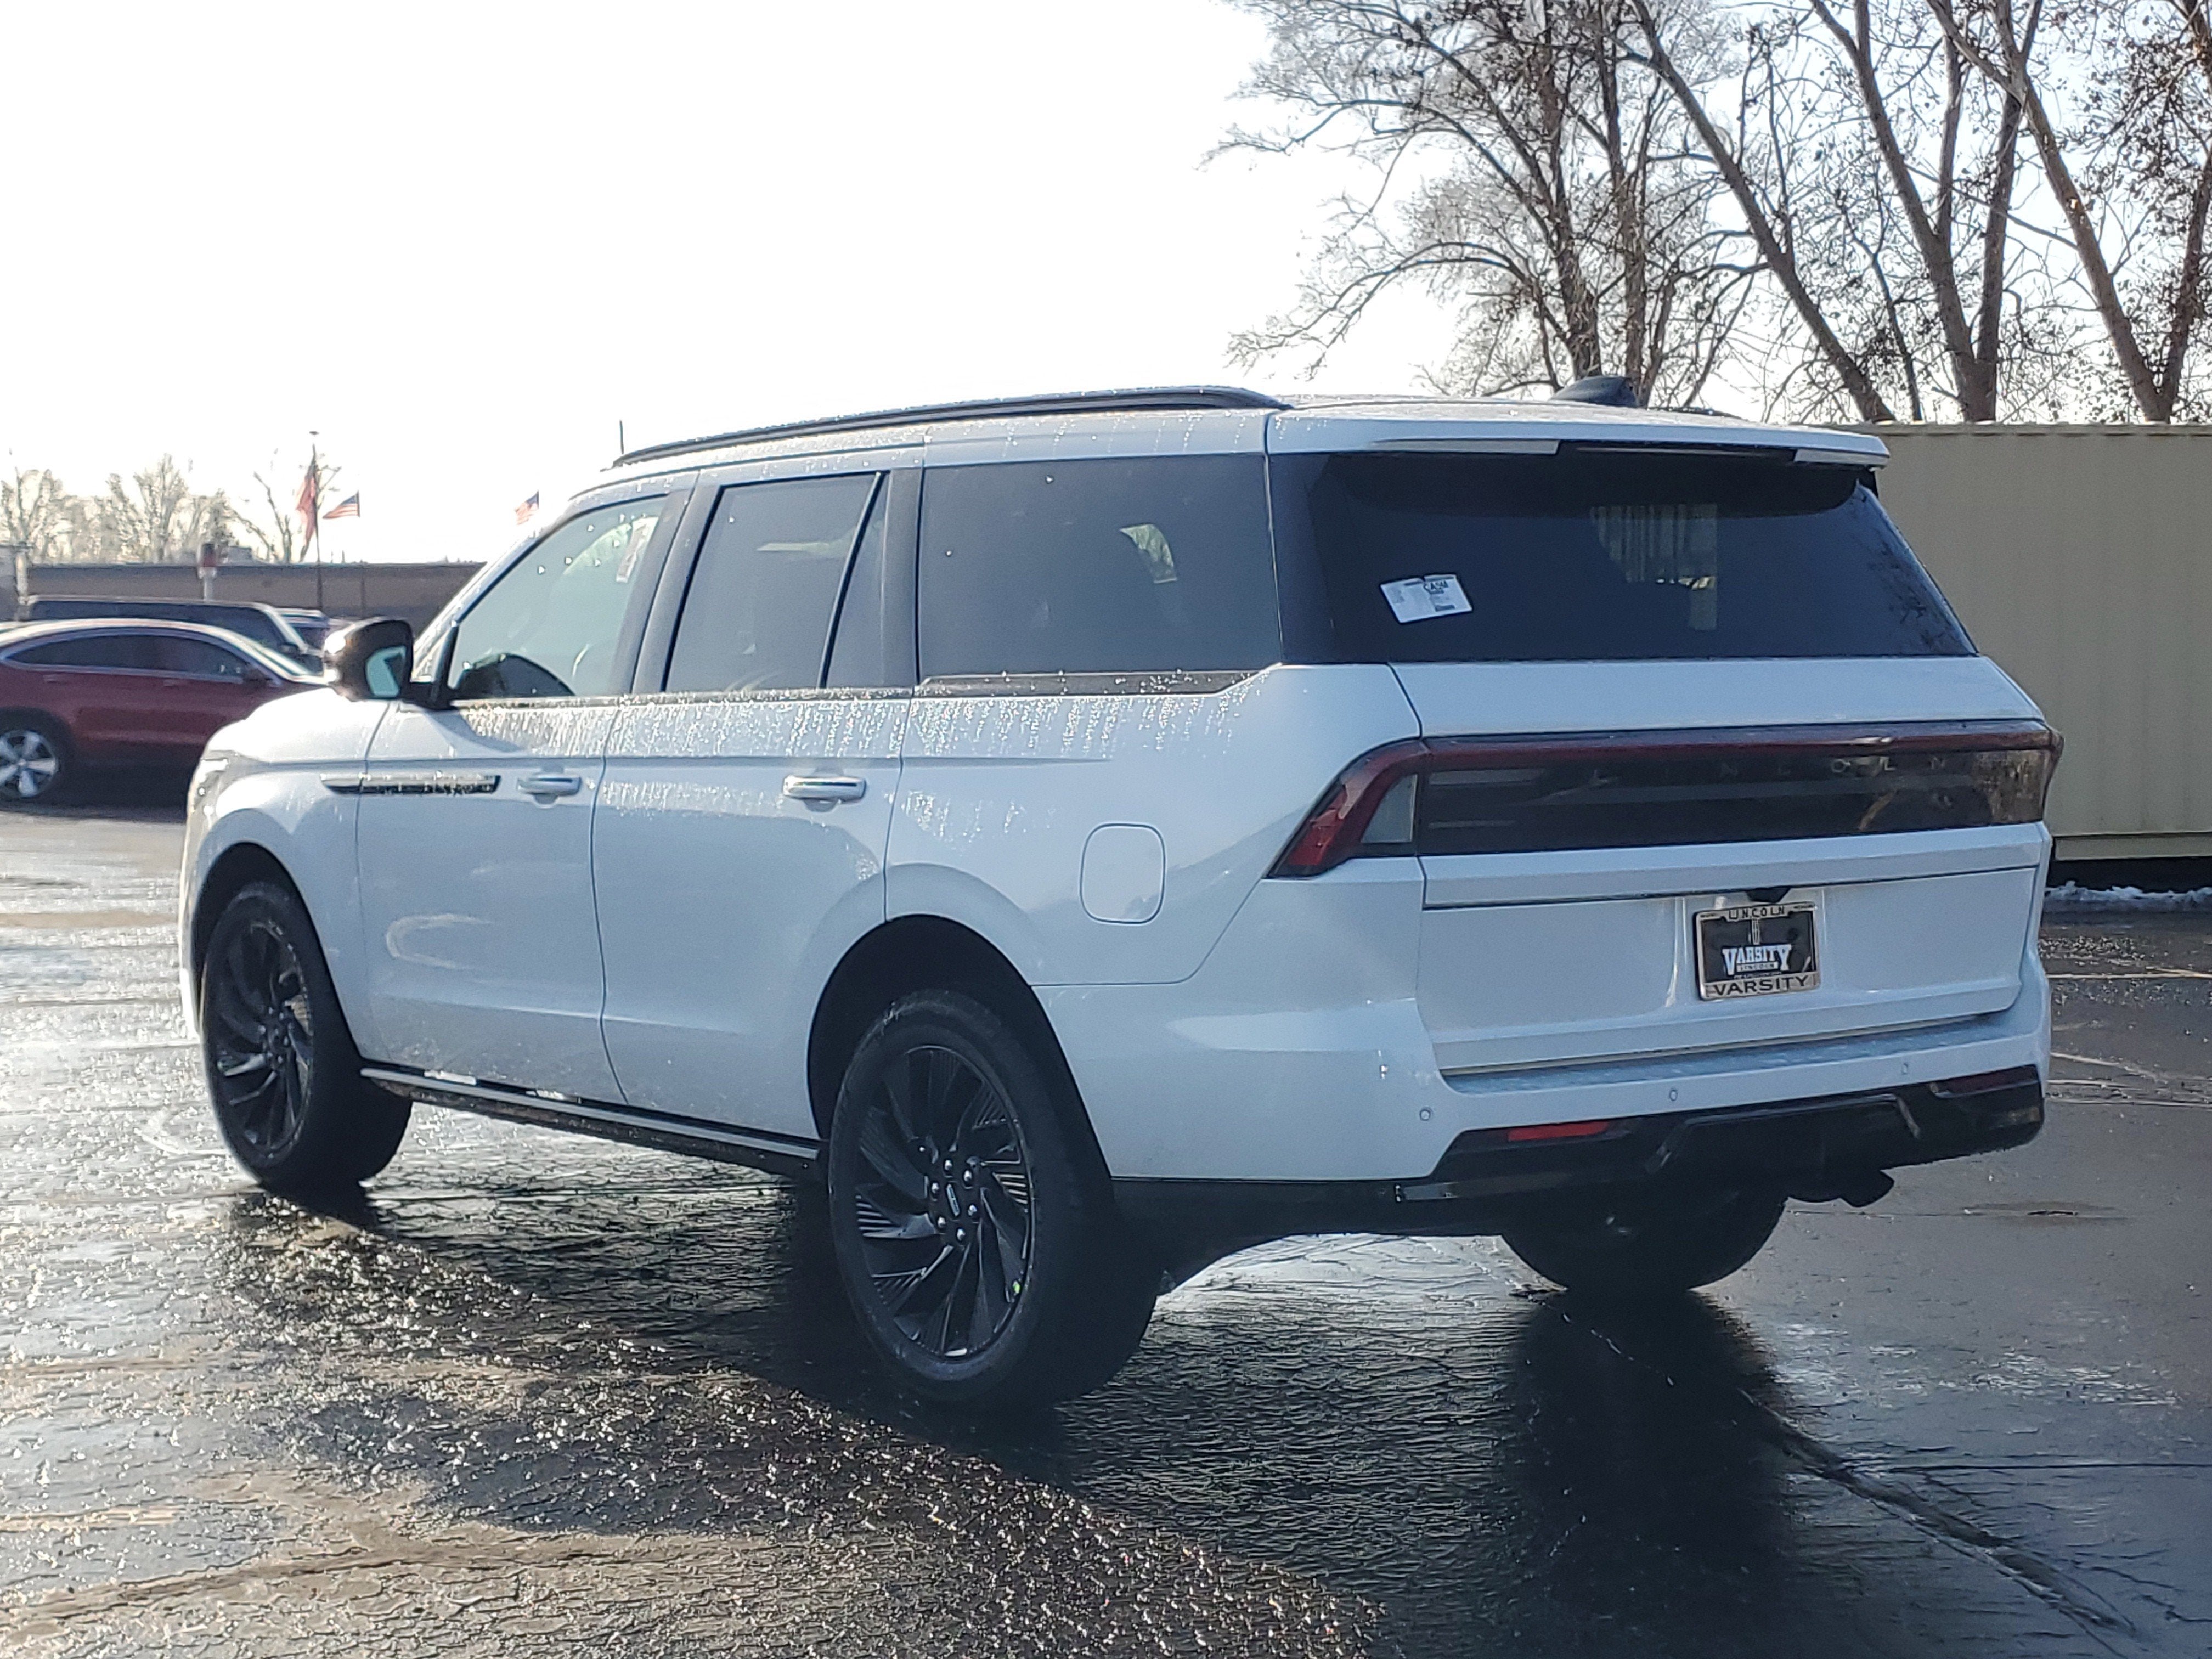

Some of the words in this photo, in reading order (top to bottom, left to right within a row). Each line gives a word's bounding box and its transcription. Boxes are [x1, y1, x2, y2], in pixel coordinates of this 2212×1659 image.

[1729, 906, 1784, 919] LINCOLN
[1722, 944, 1791, 975] VARSITY
[1714, 975, 1807, 995] VARSITY
